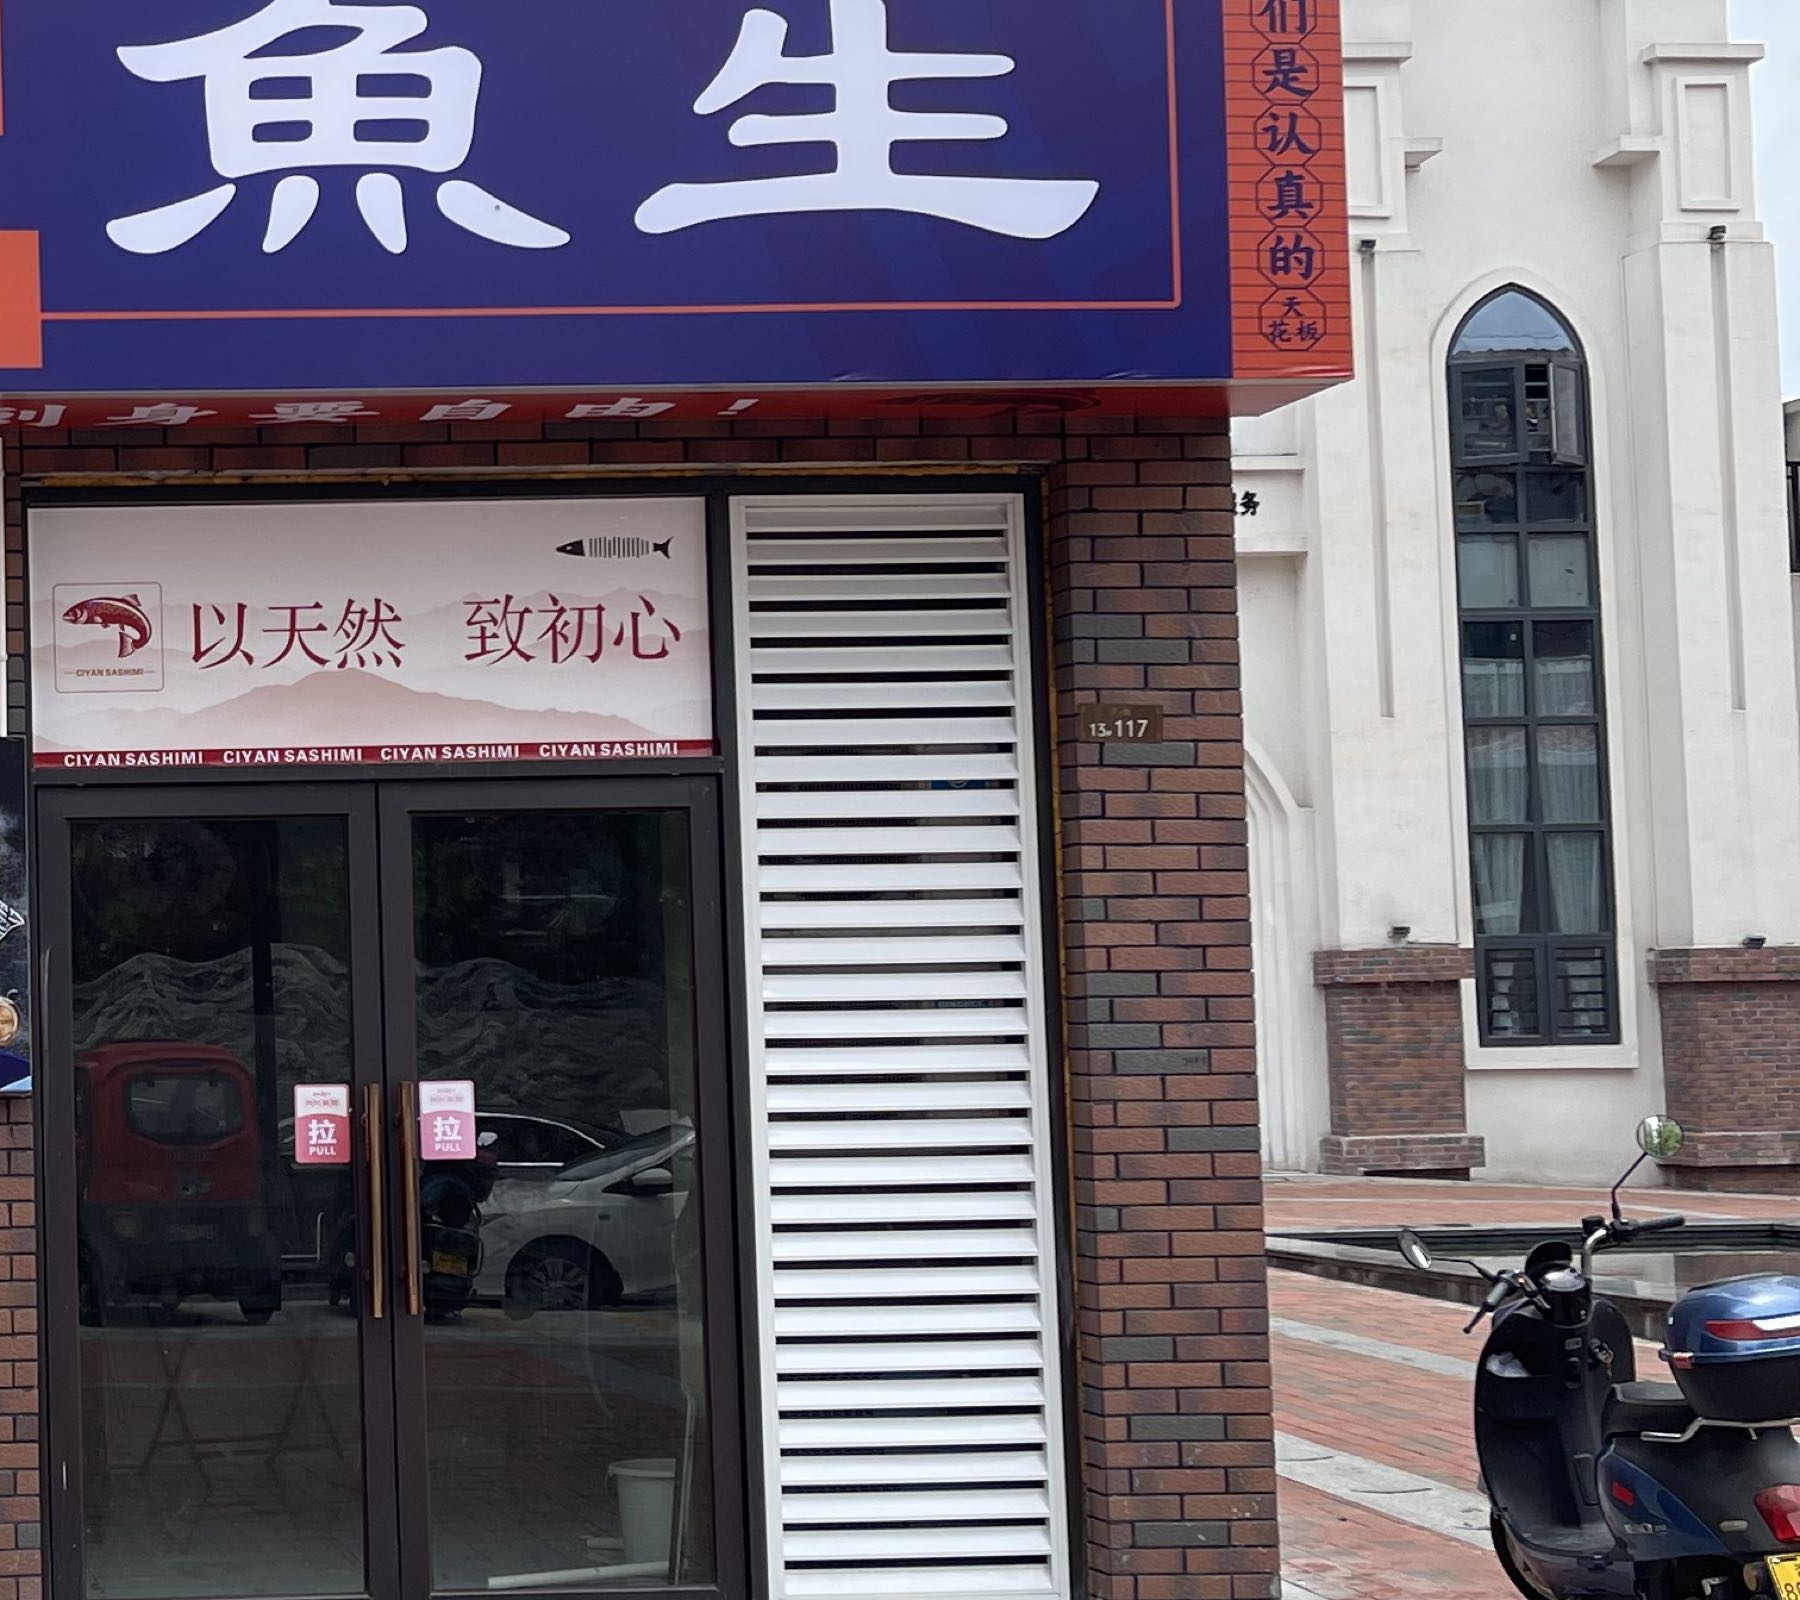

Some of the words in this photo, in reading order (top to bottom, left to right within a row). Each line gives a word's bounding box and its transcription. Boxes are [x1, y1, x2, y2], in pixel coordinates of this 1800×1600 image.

[191, 597, 405, 670] 以天然
[464, 593, 682, 666] 致初心
[63, 753, 122, 768] CIYAN
[125, 751, 204, 766] SASHIMI
[222, 749, 282, 764] CIYAN
[285, 747, 364, 763] SASHIMI
[380, 745, 440, 760] CIYAN
[443, 744, 520, 759] SASHIMI
[538, 743, 597, 758] CIYAN
[600, 741, 679, 756] SASHIMI
[309, 1119, 337, 1144] 拉
[433, 1116, 462, 1142] 拉
[309, 1146, 336, 1156] PULL
[434, 1143, 461, 1152] PULL
